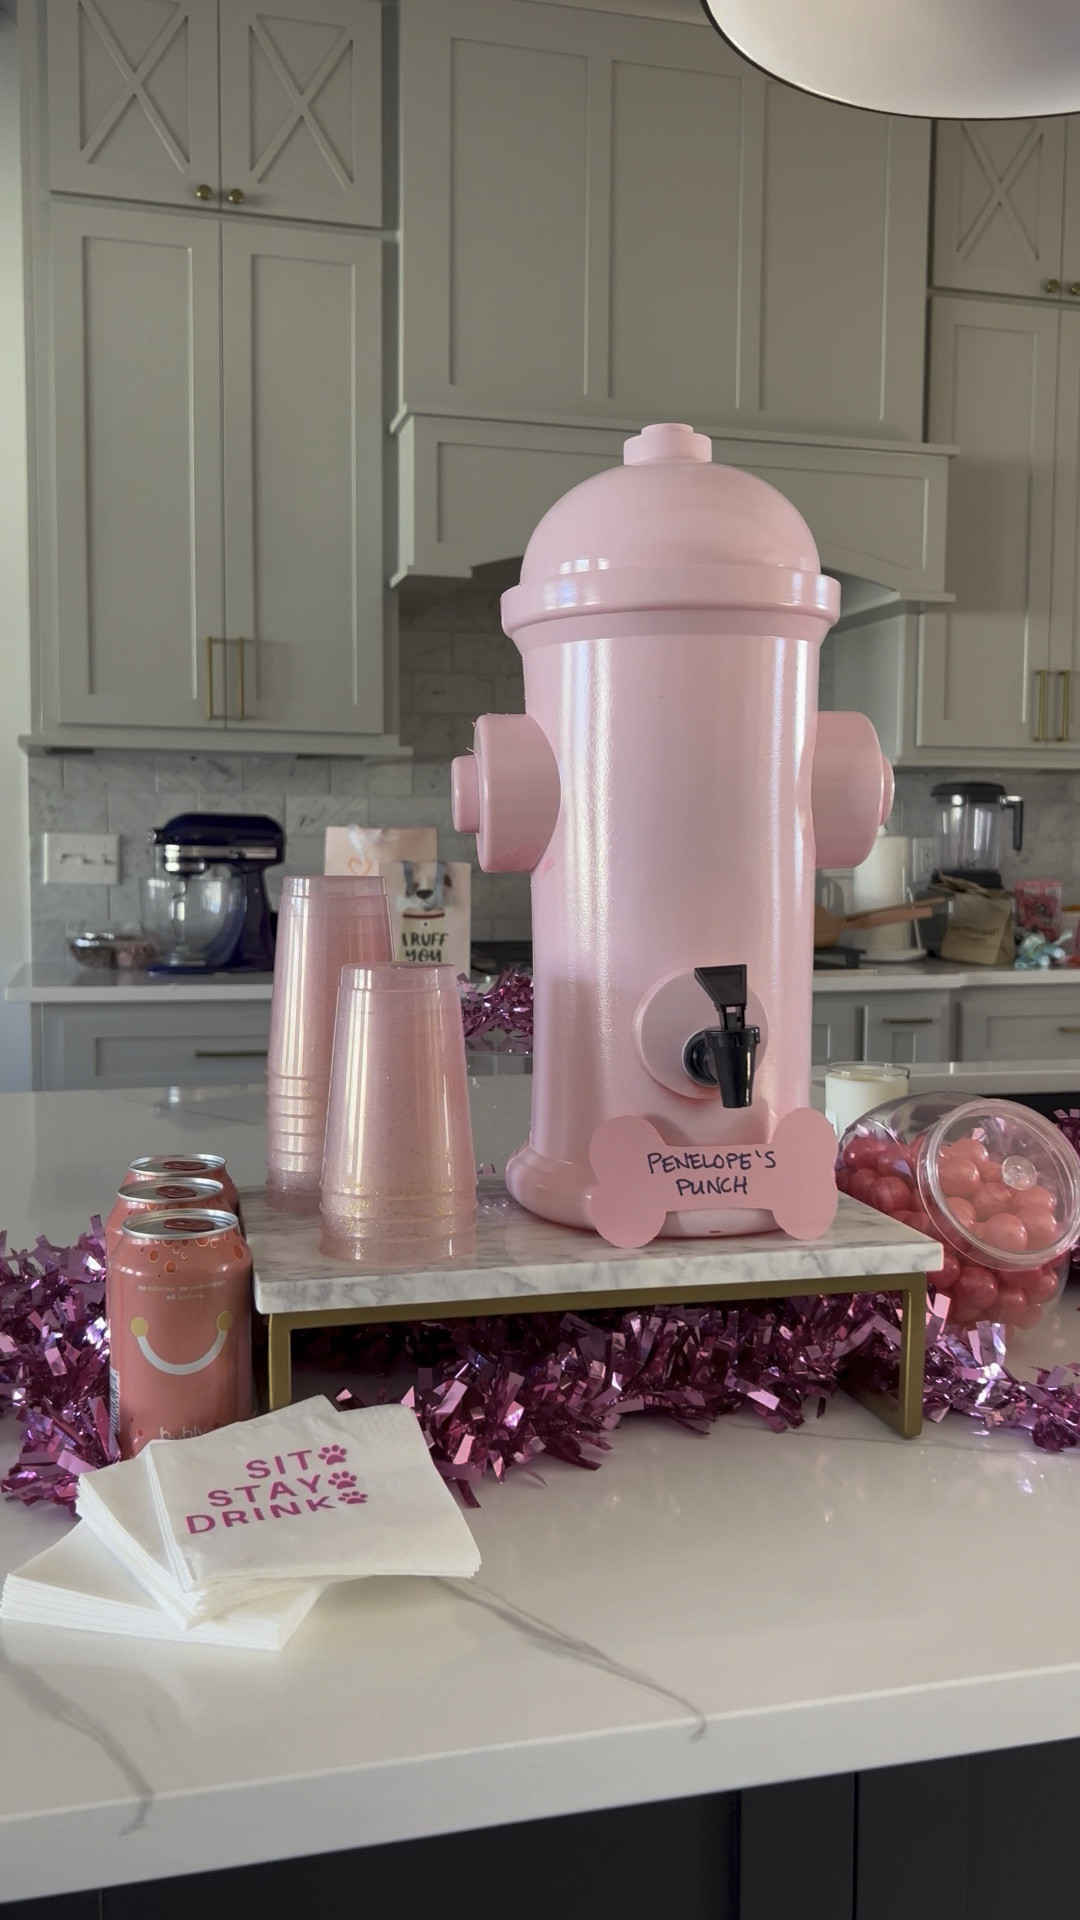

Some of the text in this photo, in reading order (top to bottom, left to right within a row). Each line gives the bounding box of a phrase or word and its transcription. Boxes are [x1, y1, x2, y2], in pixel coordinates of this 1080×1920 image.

[402, 932, 449, 947] I RUFF
[405, 948, 442, 962] YOU
[647, 1150, 776, 1174] PENELOPE'S
[676, 1176, 748, 1196] PUNCH
[246, 1450, 312, 1479] SIT
[207, 1474, 321, 1507] STAY
[186, 1495, 337, 1534] DRINK
